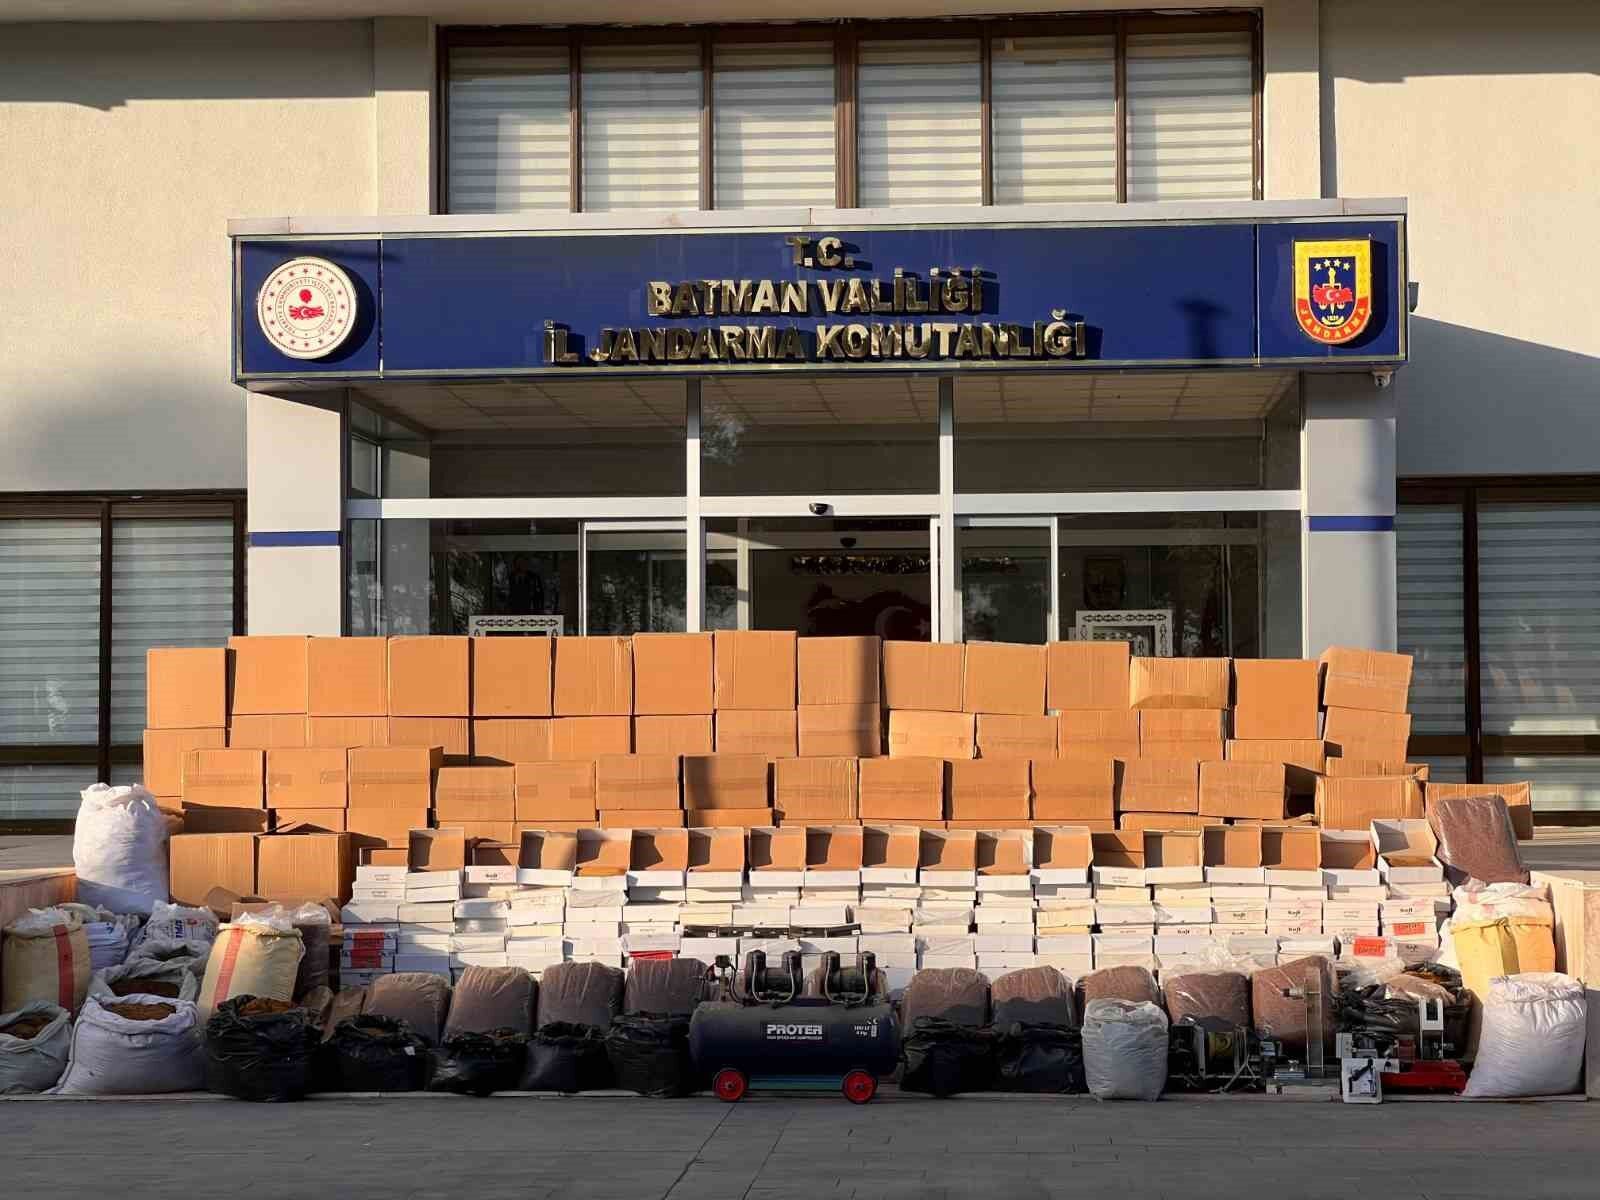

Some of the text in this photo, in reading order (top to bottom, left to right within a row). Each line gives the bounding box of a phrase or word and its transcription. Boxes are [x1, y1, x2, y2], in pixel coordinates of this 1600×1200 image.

[785, 236, 854, 268] T.C.
[648, 267, 982, 315] BATMAN VALİLİĞİ
[544, 309, 1086, 363] İL JANDARMA KOMUTANLIĞI
[767, 1024, 823, 1035] PROTER
